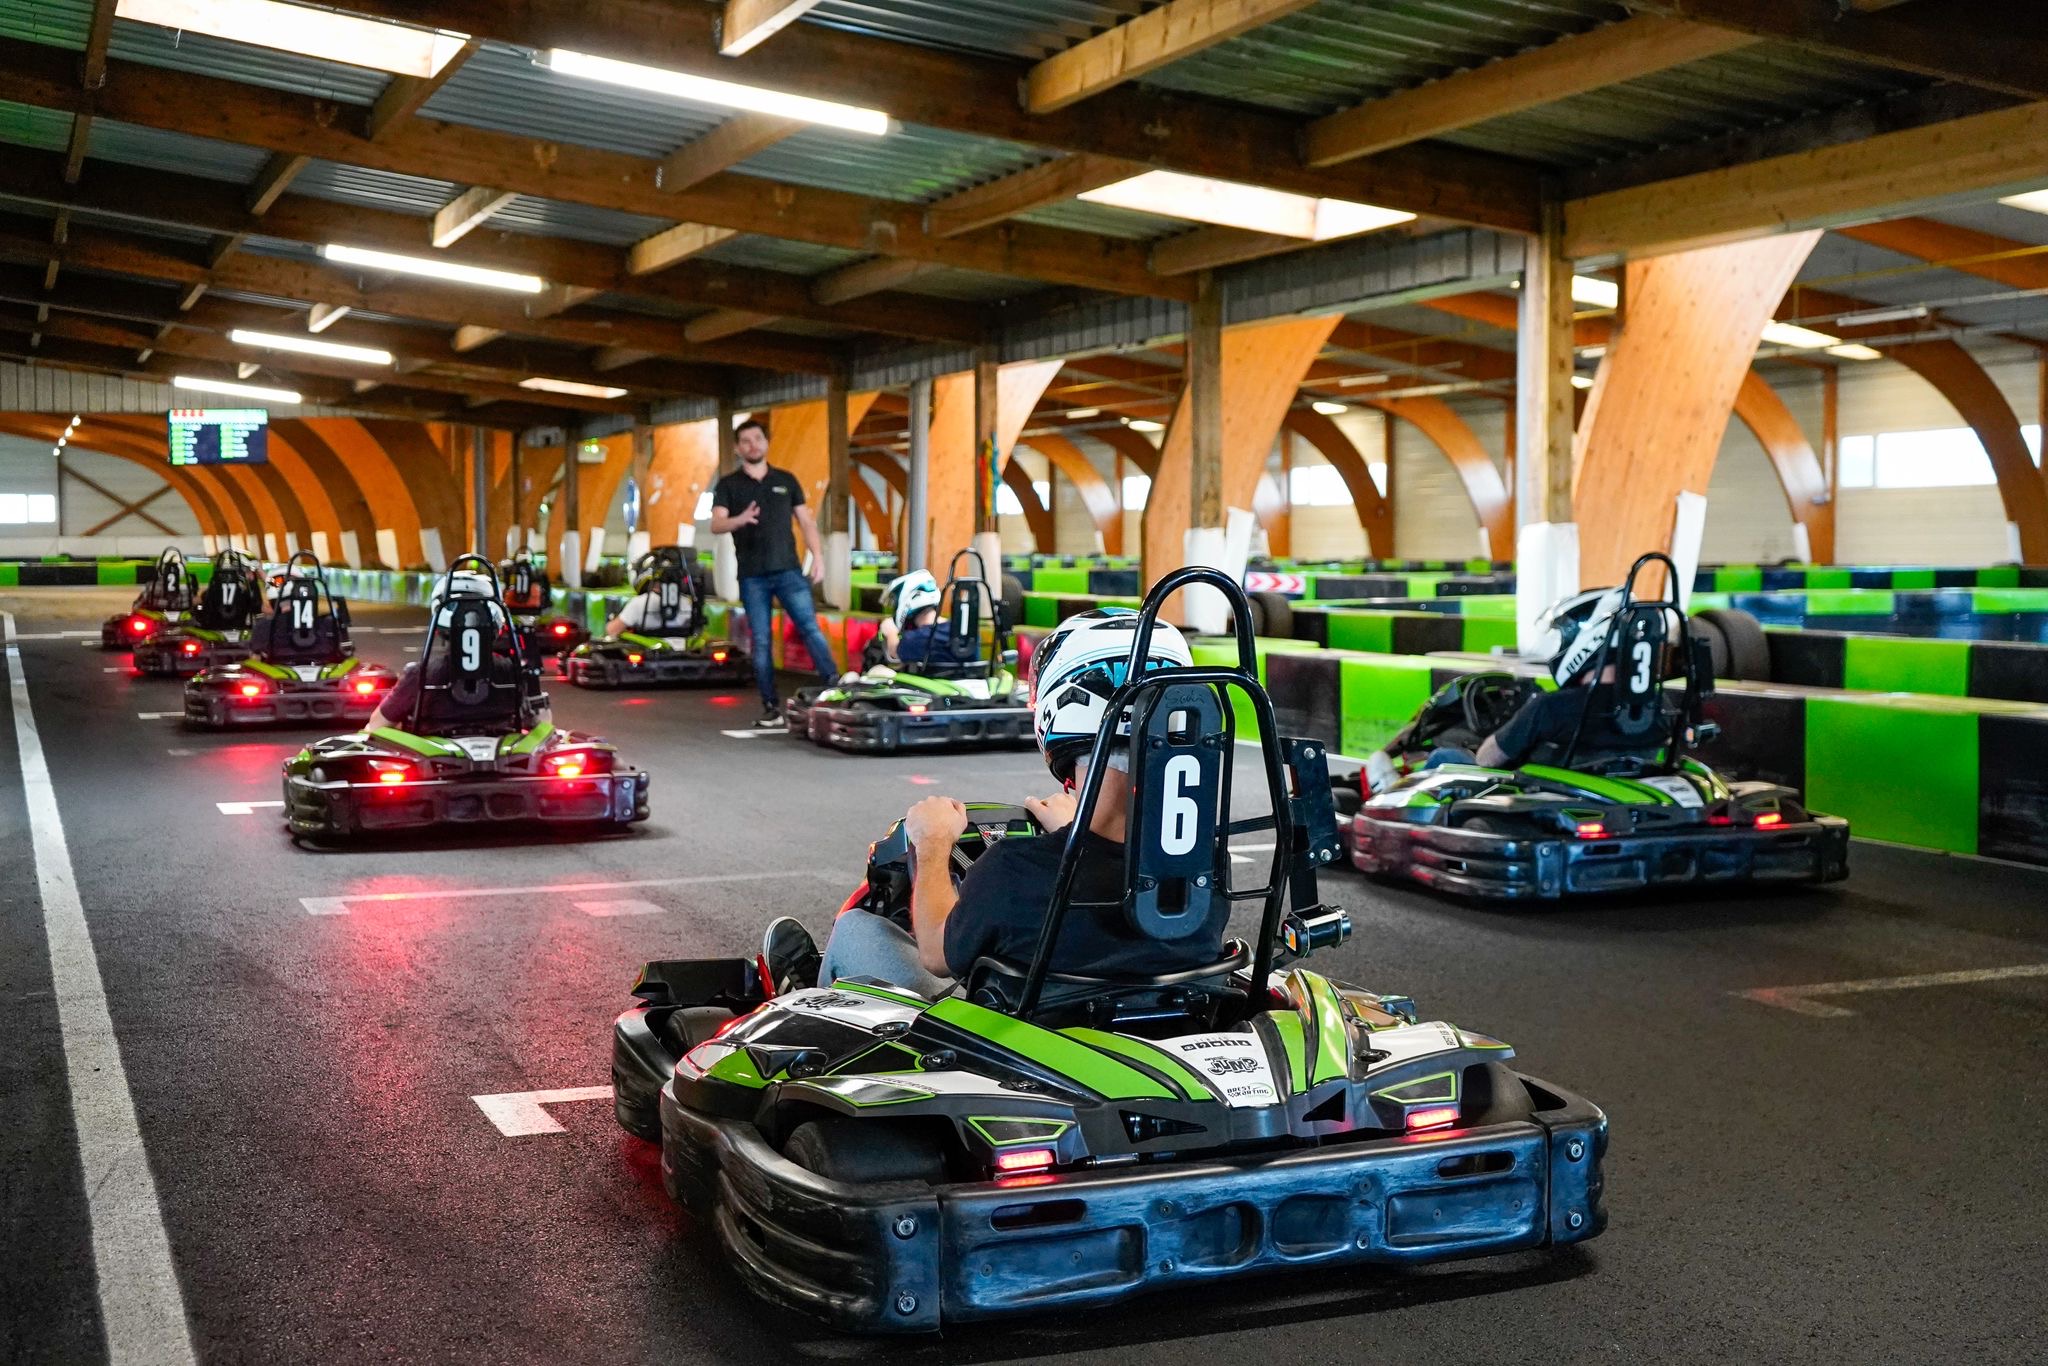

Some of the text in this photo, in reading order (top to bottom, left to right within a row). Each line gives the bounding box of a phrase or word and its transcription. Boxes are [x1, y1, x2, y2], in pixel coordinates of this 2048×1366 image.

[167, 573, 176, 592] 2
[221, 583, 237, 605] 17
[661, 583, 679, 607] 18
[293, 600, 314, 629] 14
[960, 603, 969, 636] 1
[462, 629, 480, 671] 9
[1630, 641, 1652, 694] 3
[1160, 754, 1201, 856] 6
[1207, 1056, 1258, 1075] JUMP
